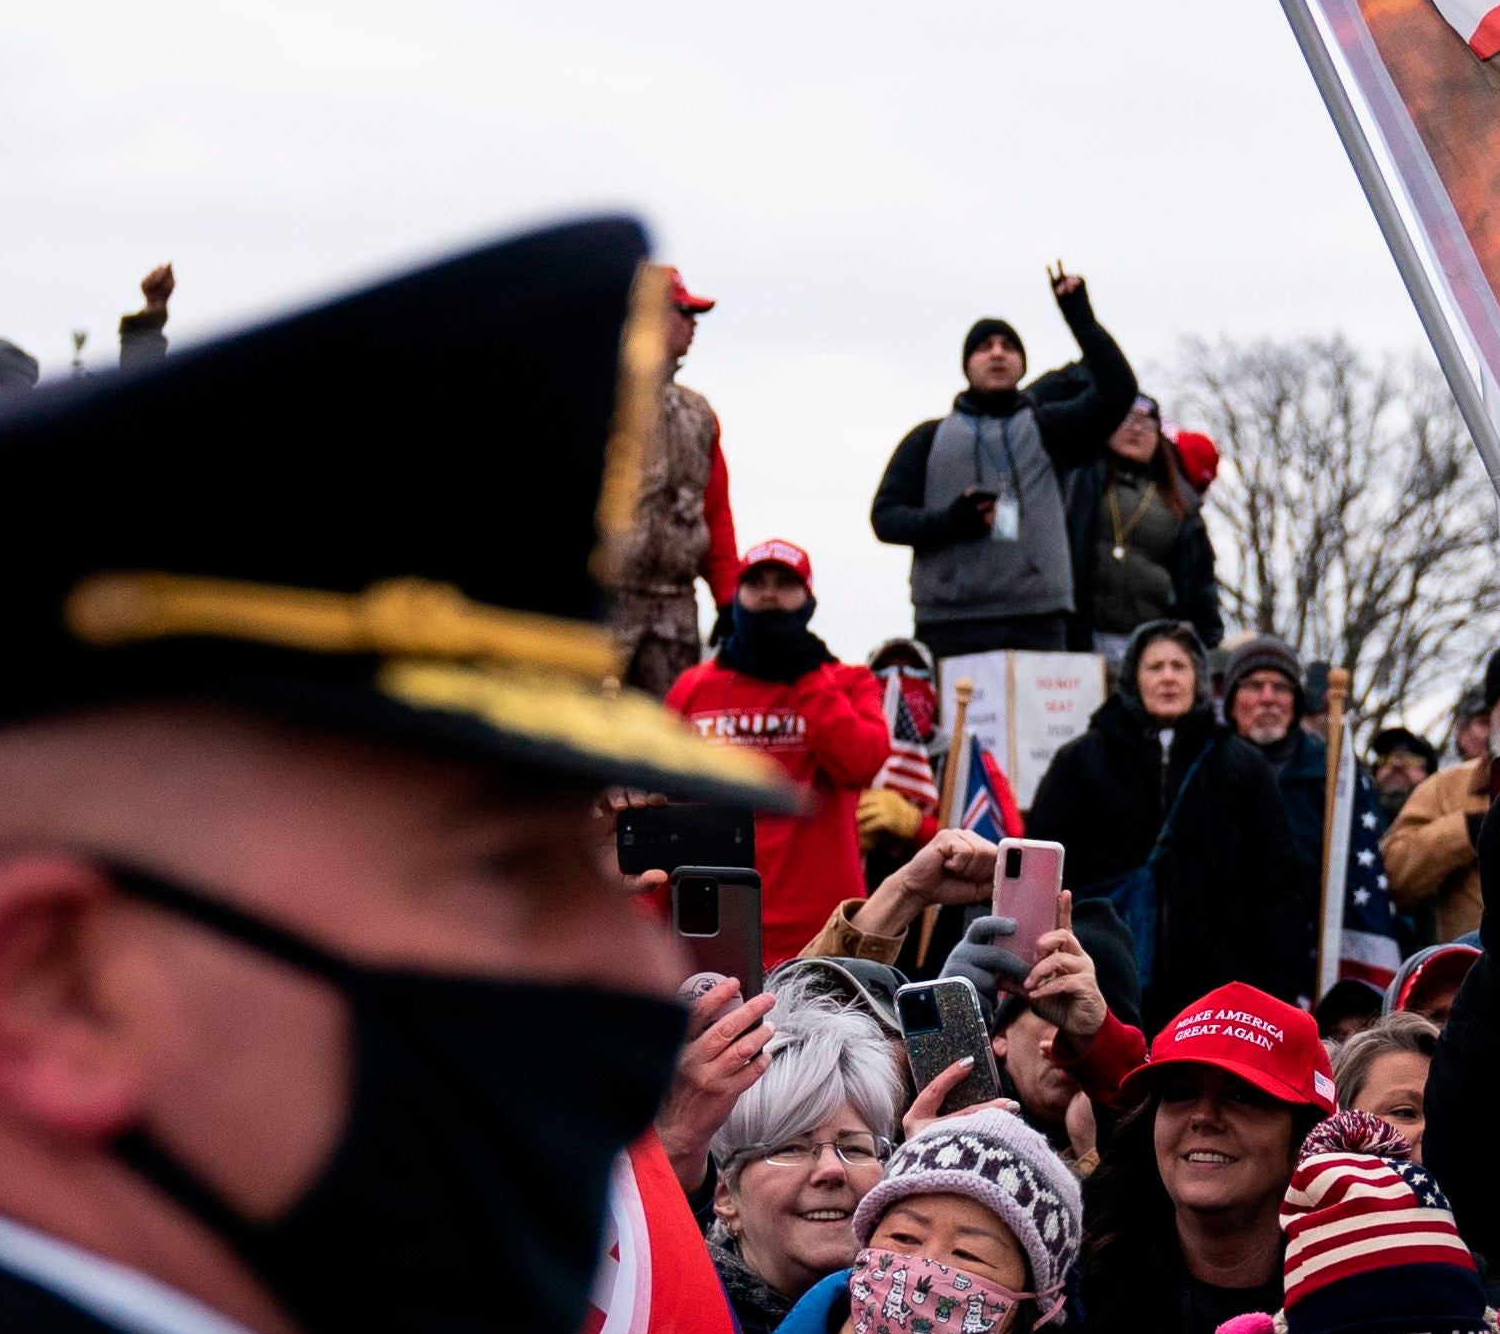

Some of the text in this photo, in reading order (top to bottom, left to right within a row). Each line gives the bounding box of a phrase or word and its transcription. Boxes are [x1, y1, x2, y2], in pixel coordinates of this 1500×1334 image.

[1174, 1008, 1284, 1043] MAKE AMERICA
[1174, 1024, 1274, 1052] GREAT AGAIN
